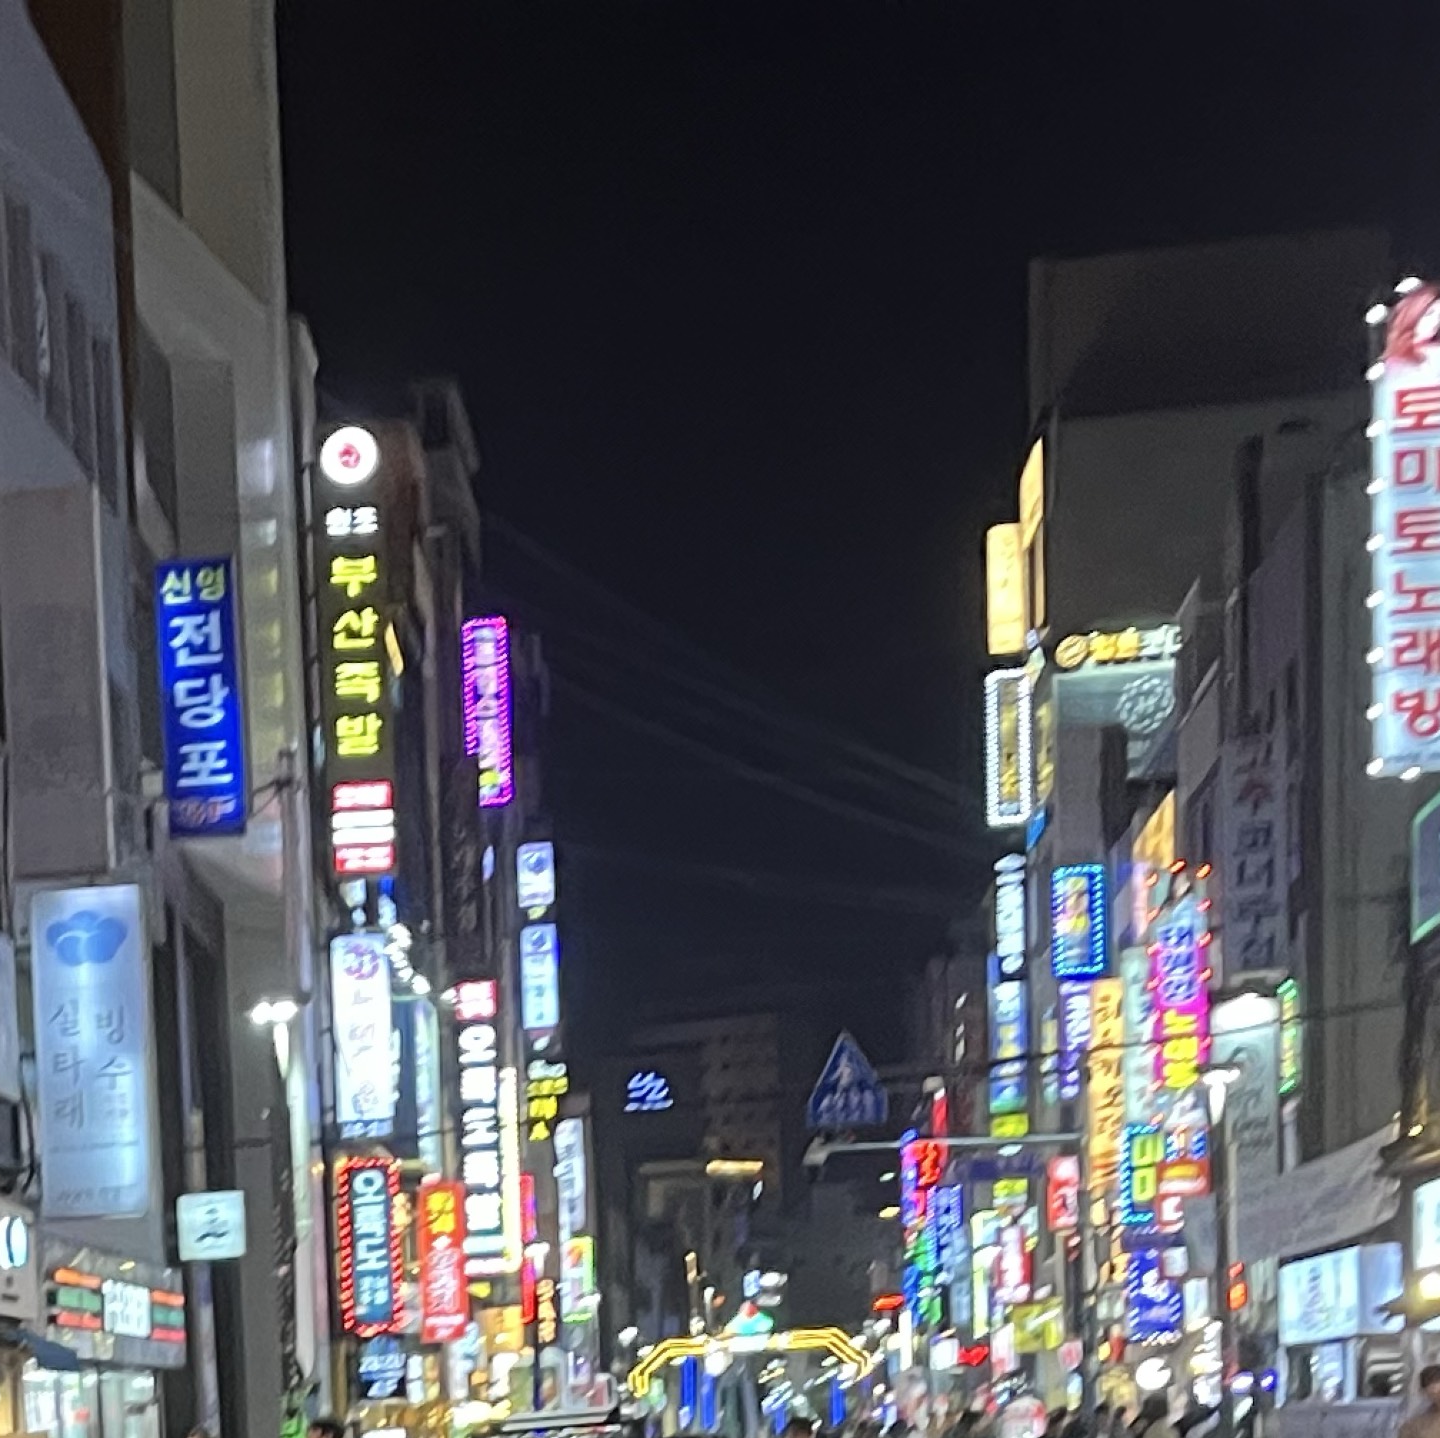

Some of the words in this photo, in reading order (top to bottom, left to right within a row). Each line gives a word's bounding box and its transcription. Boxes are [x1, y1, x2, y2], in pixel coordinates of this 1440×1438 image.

[168, 608, 234, 789] 전당포
[329, 554, 384, 758] 부산족발
[48, 998, 87, 1131] 실타래
